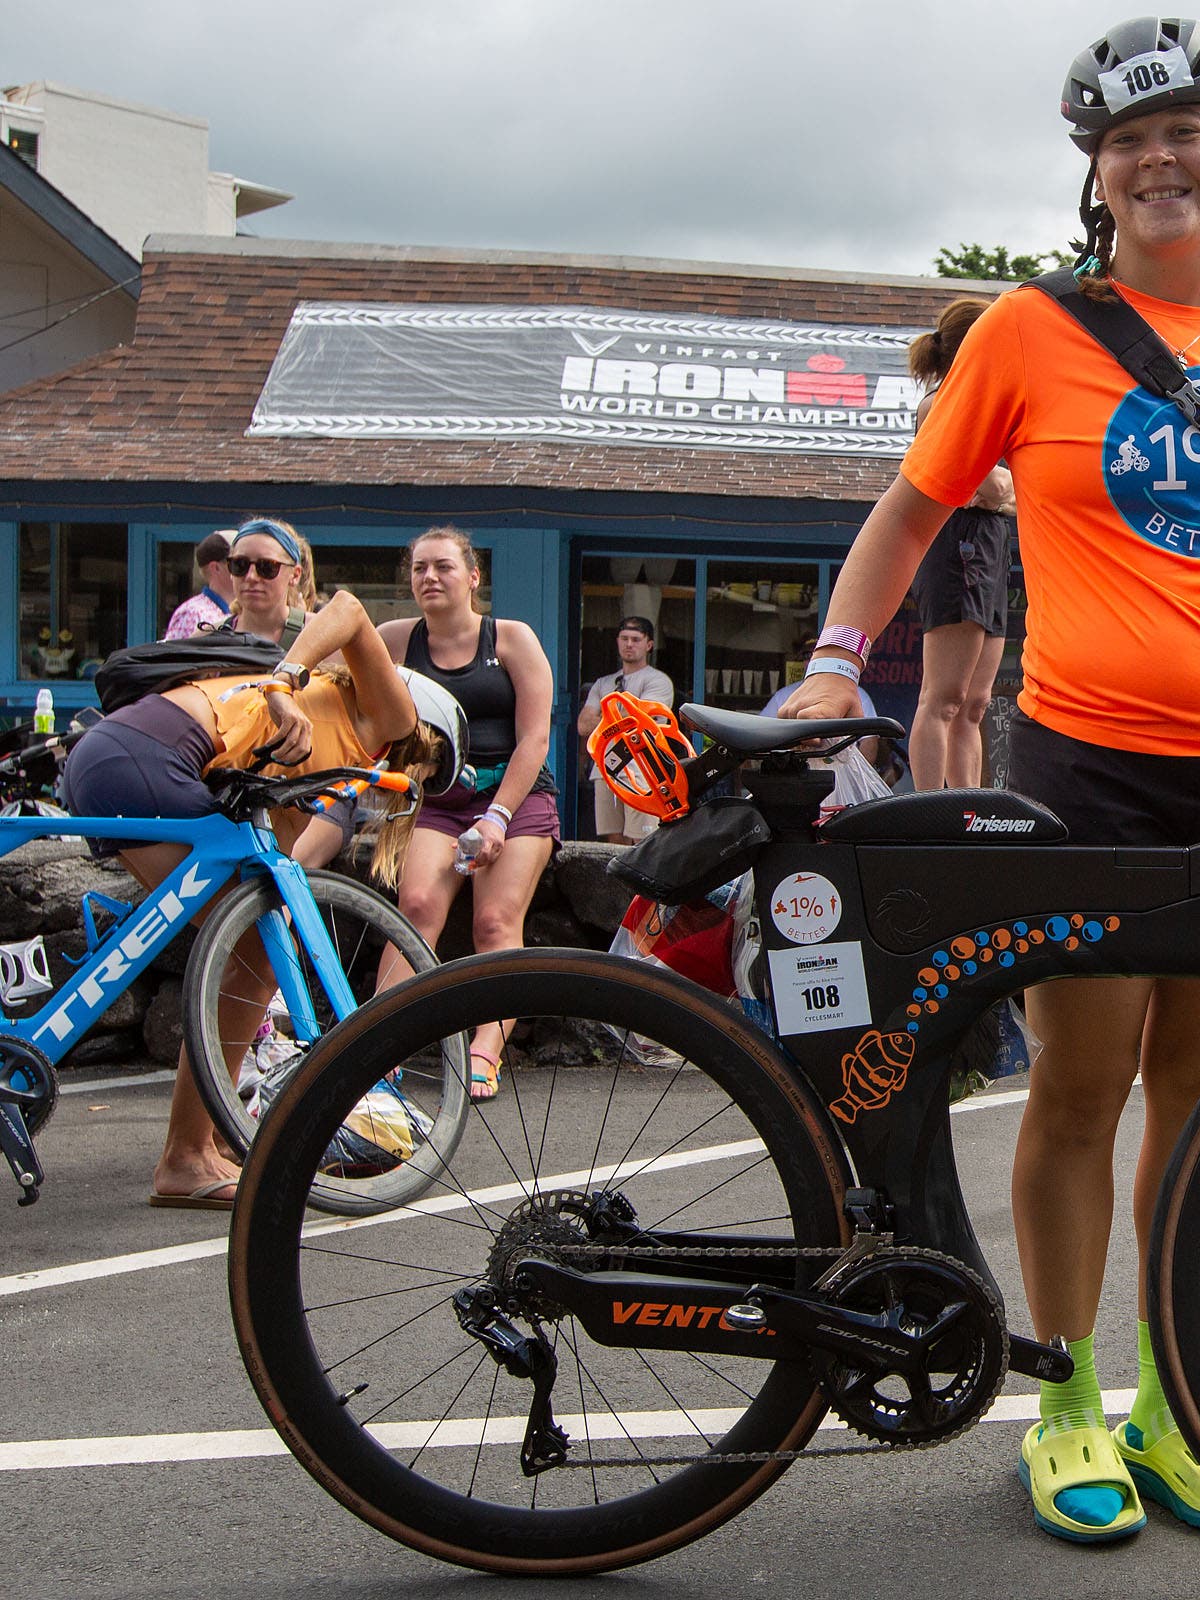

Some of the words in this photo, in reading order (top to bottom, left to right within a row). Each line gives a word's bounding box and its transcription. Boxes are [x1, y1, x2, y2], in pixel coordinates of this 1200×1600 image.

[1122, 61, 1170, 96] 108
[635, 343, 781, 361] VINFAST
[561, 354, 922, 410] IRONMA
[560, 394, 699, 418] WORLD
[711, 401, 916, 430] CHAMPION
[790, 897, 823, 918] 1%
[787, 926, 827, 941] BETTER
[32, 862, 212, 1042] TREK
[801, 985, 840, 1010] 108
[805, 1012, 844, 1022] CYCLESMART
[612, 1301, 776, 1336] VENT
[817, 1325, 909, 1355] DURA-ACE
